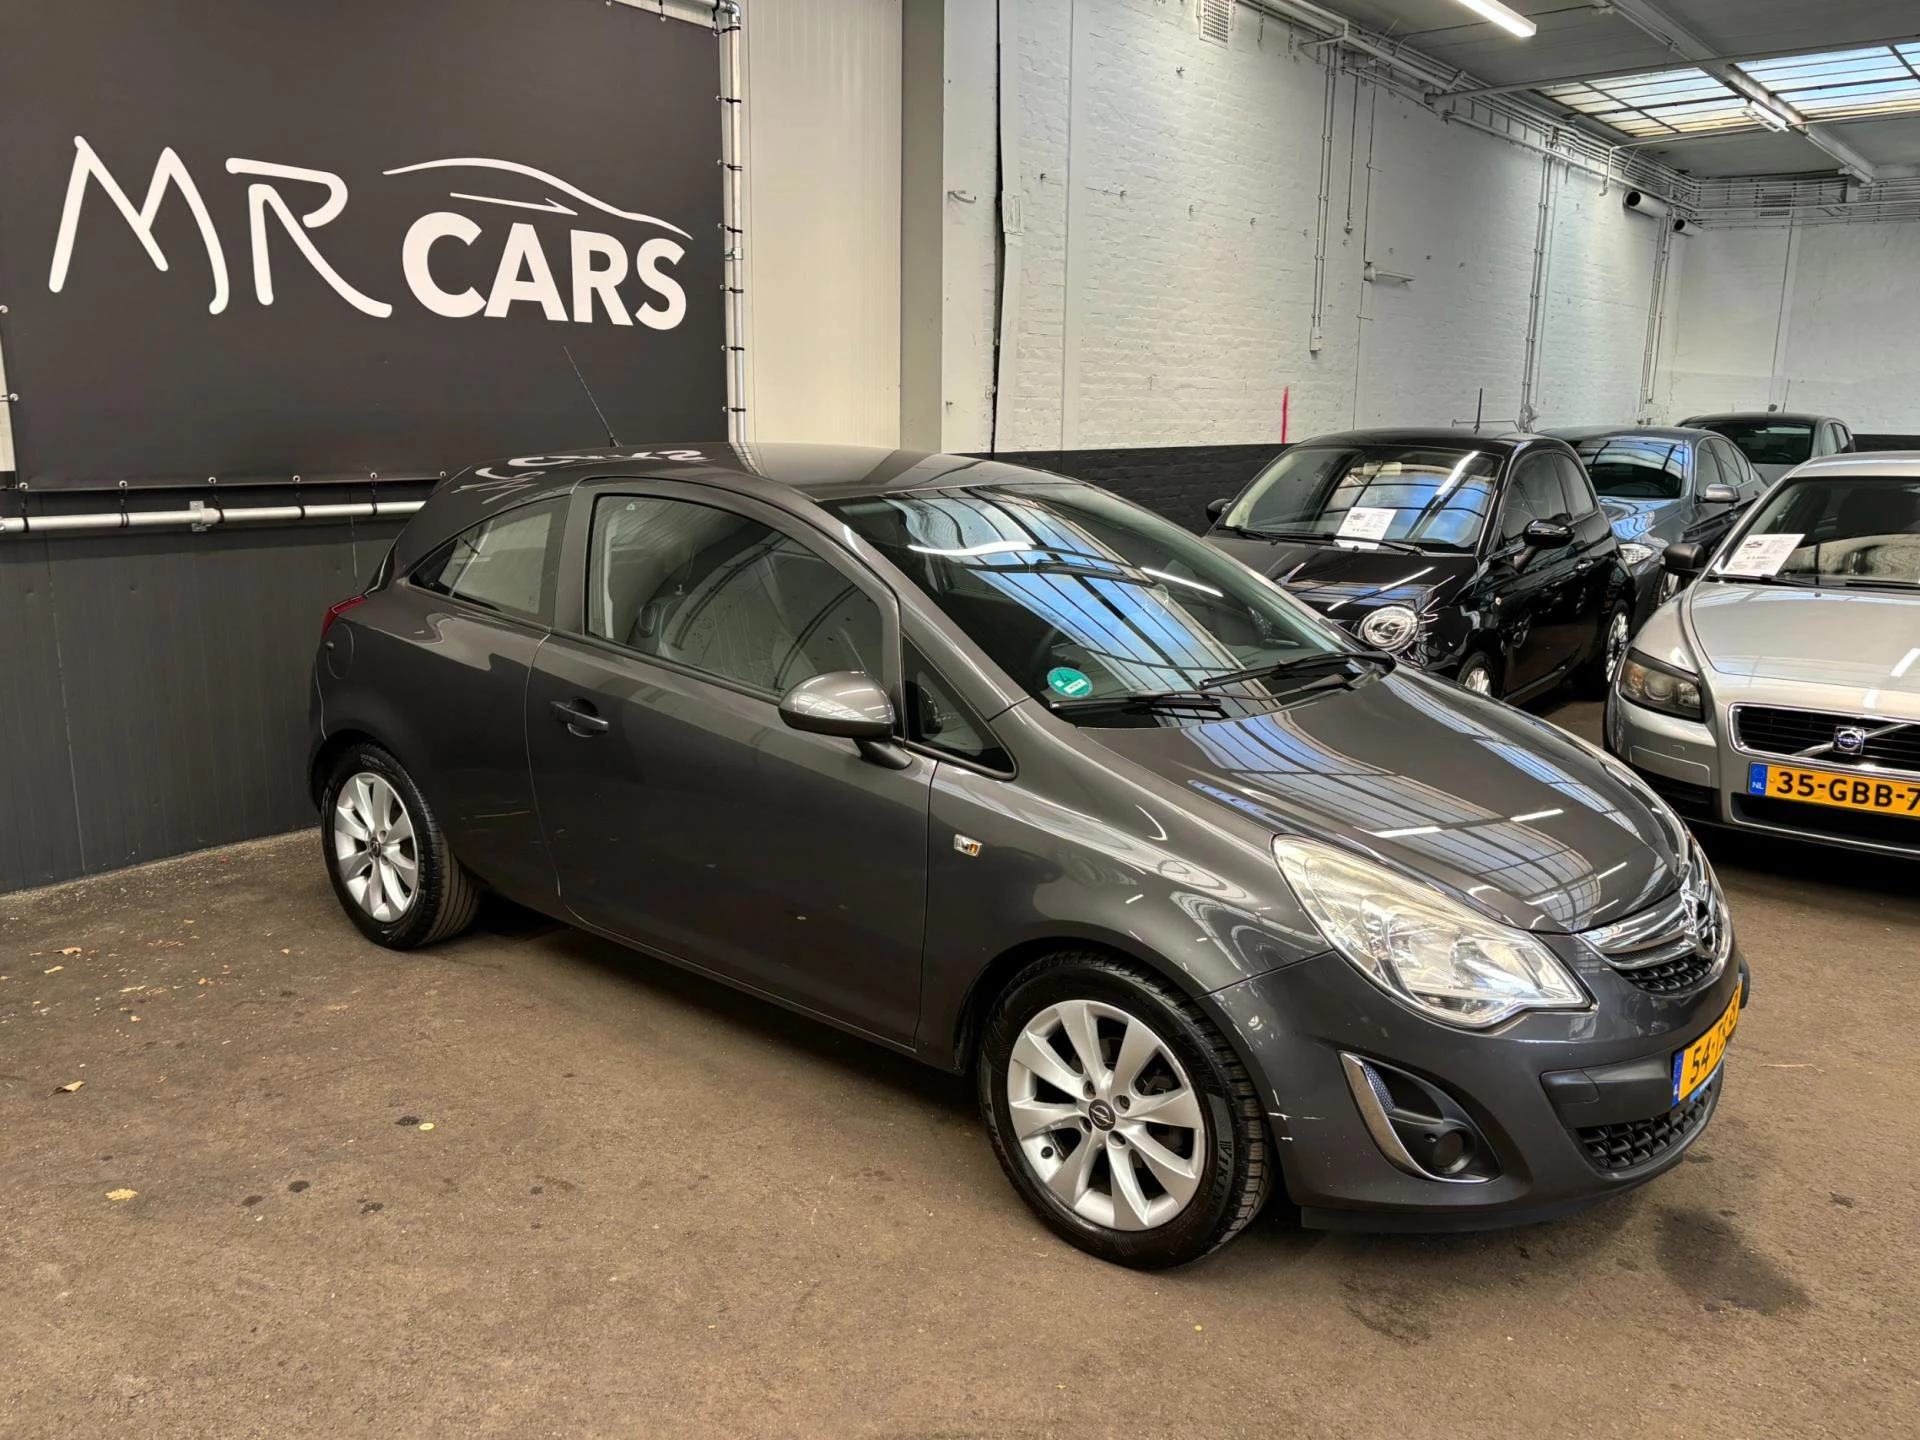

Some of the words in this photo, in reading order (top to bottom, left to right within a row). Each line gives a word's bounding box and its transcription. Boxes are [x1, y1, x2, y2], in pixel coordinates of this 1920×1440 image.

[49, 135, 393, 319] MR
[402, 212, 687, 330] CARS
[1752, 781, 1764, 790] NL
[1776, 771, 1920, 811] 35-GBB-7
